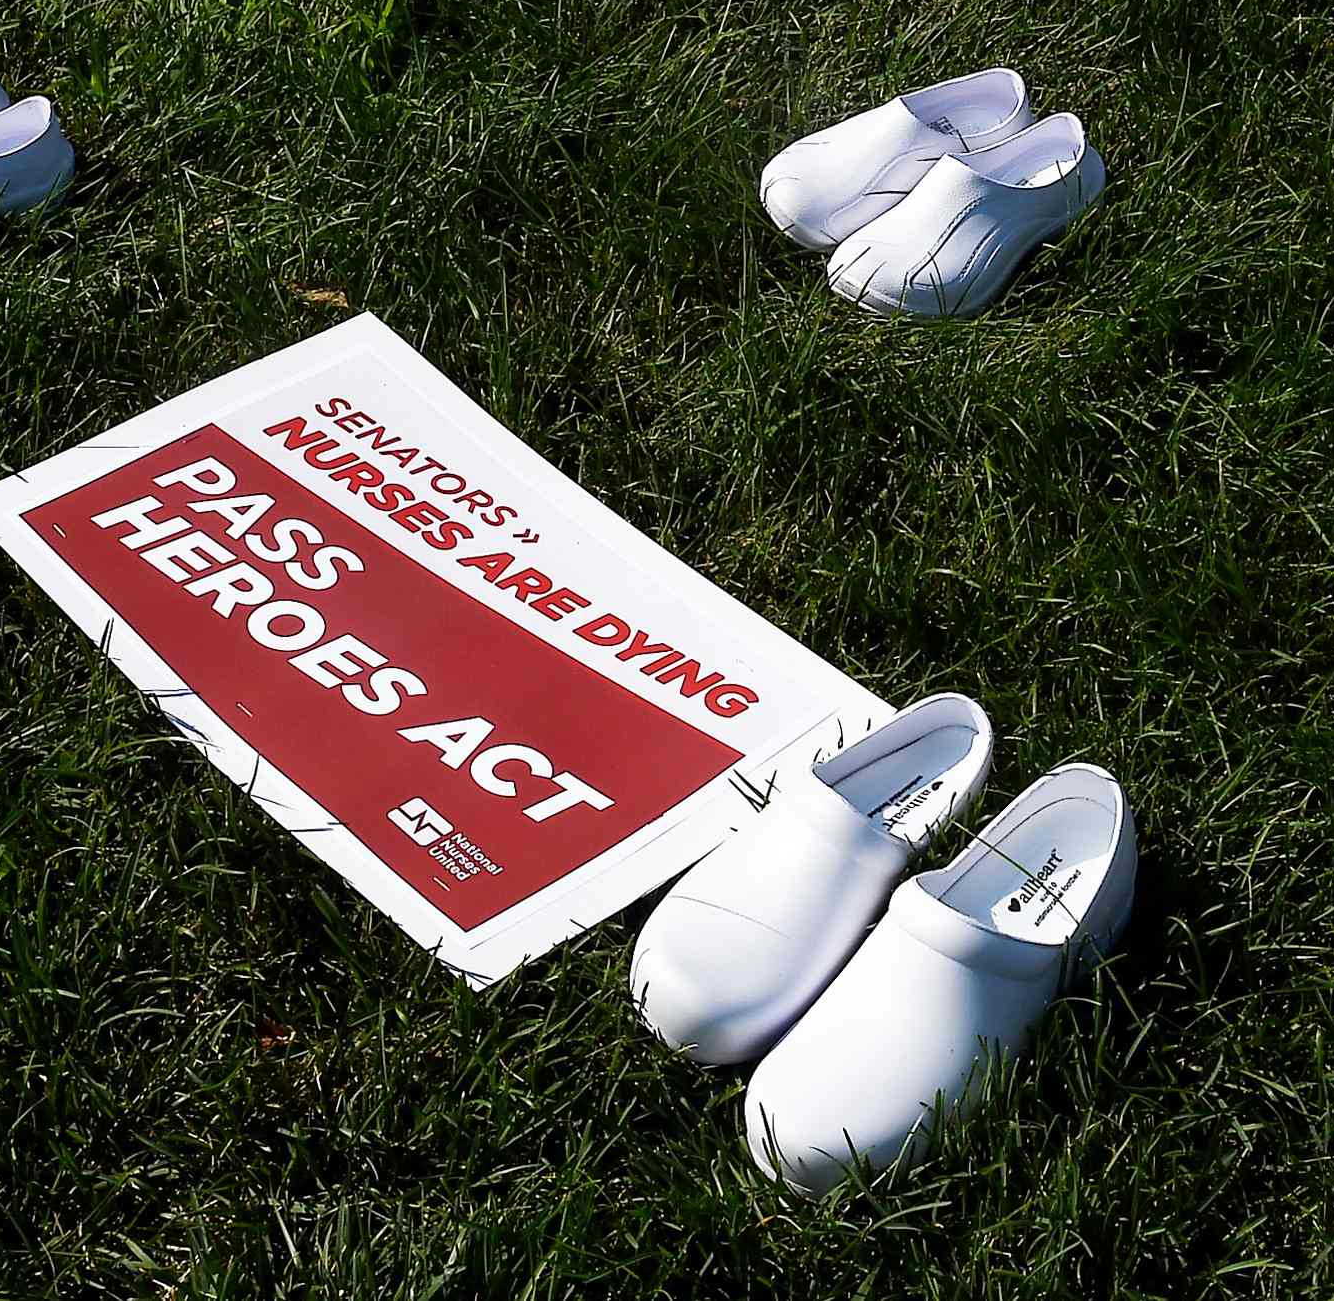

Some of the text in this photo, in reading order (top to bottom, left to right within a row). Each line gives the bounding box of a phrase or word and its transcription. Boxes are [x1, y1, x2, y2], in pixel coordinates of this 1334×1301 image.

[153, 456, 365, 591] PASS
[314, 397, 519, 527] SENATORS
[264, 416, 760, 719] NURSES ARE DYING
[90, 495, 615, 822] HEROES ACT
[428, 846, 471, 881] United
[440, 839, 481, 875] Nurses
[451, 832, 504, 875] National
